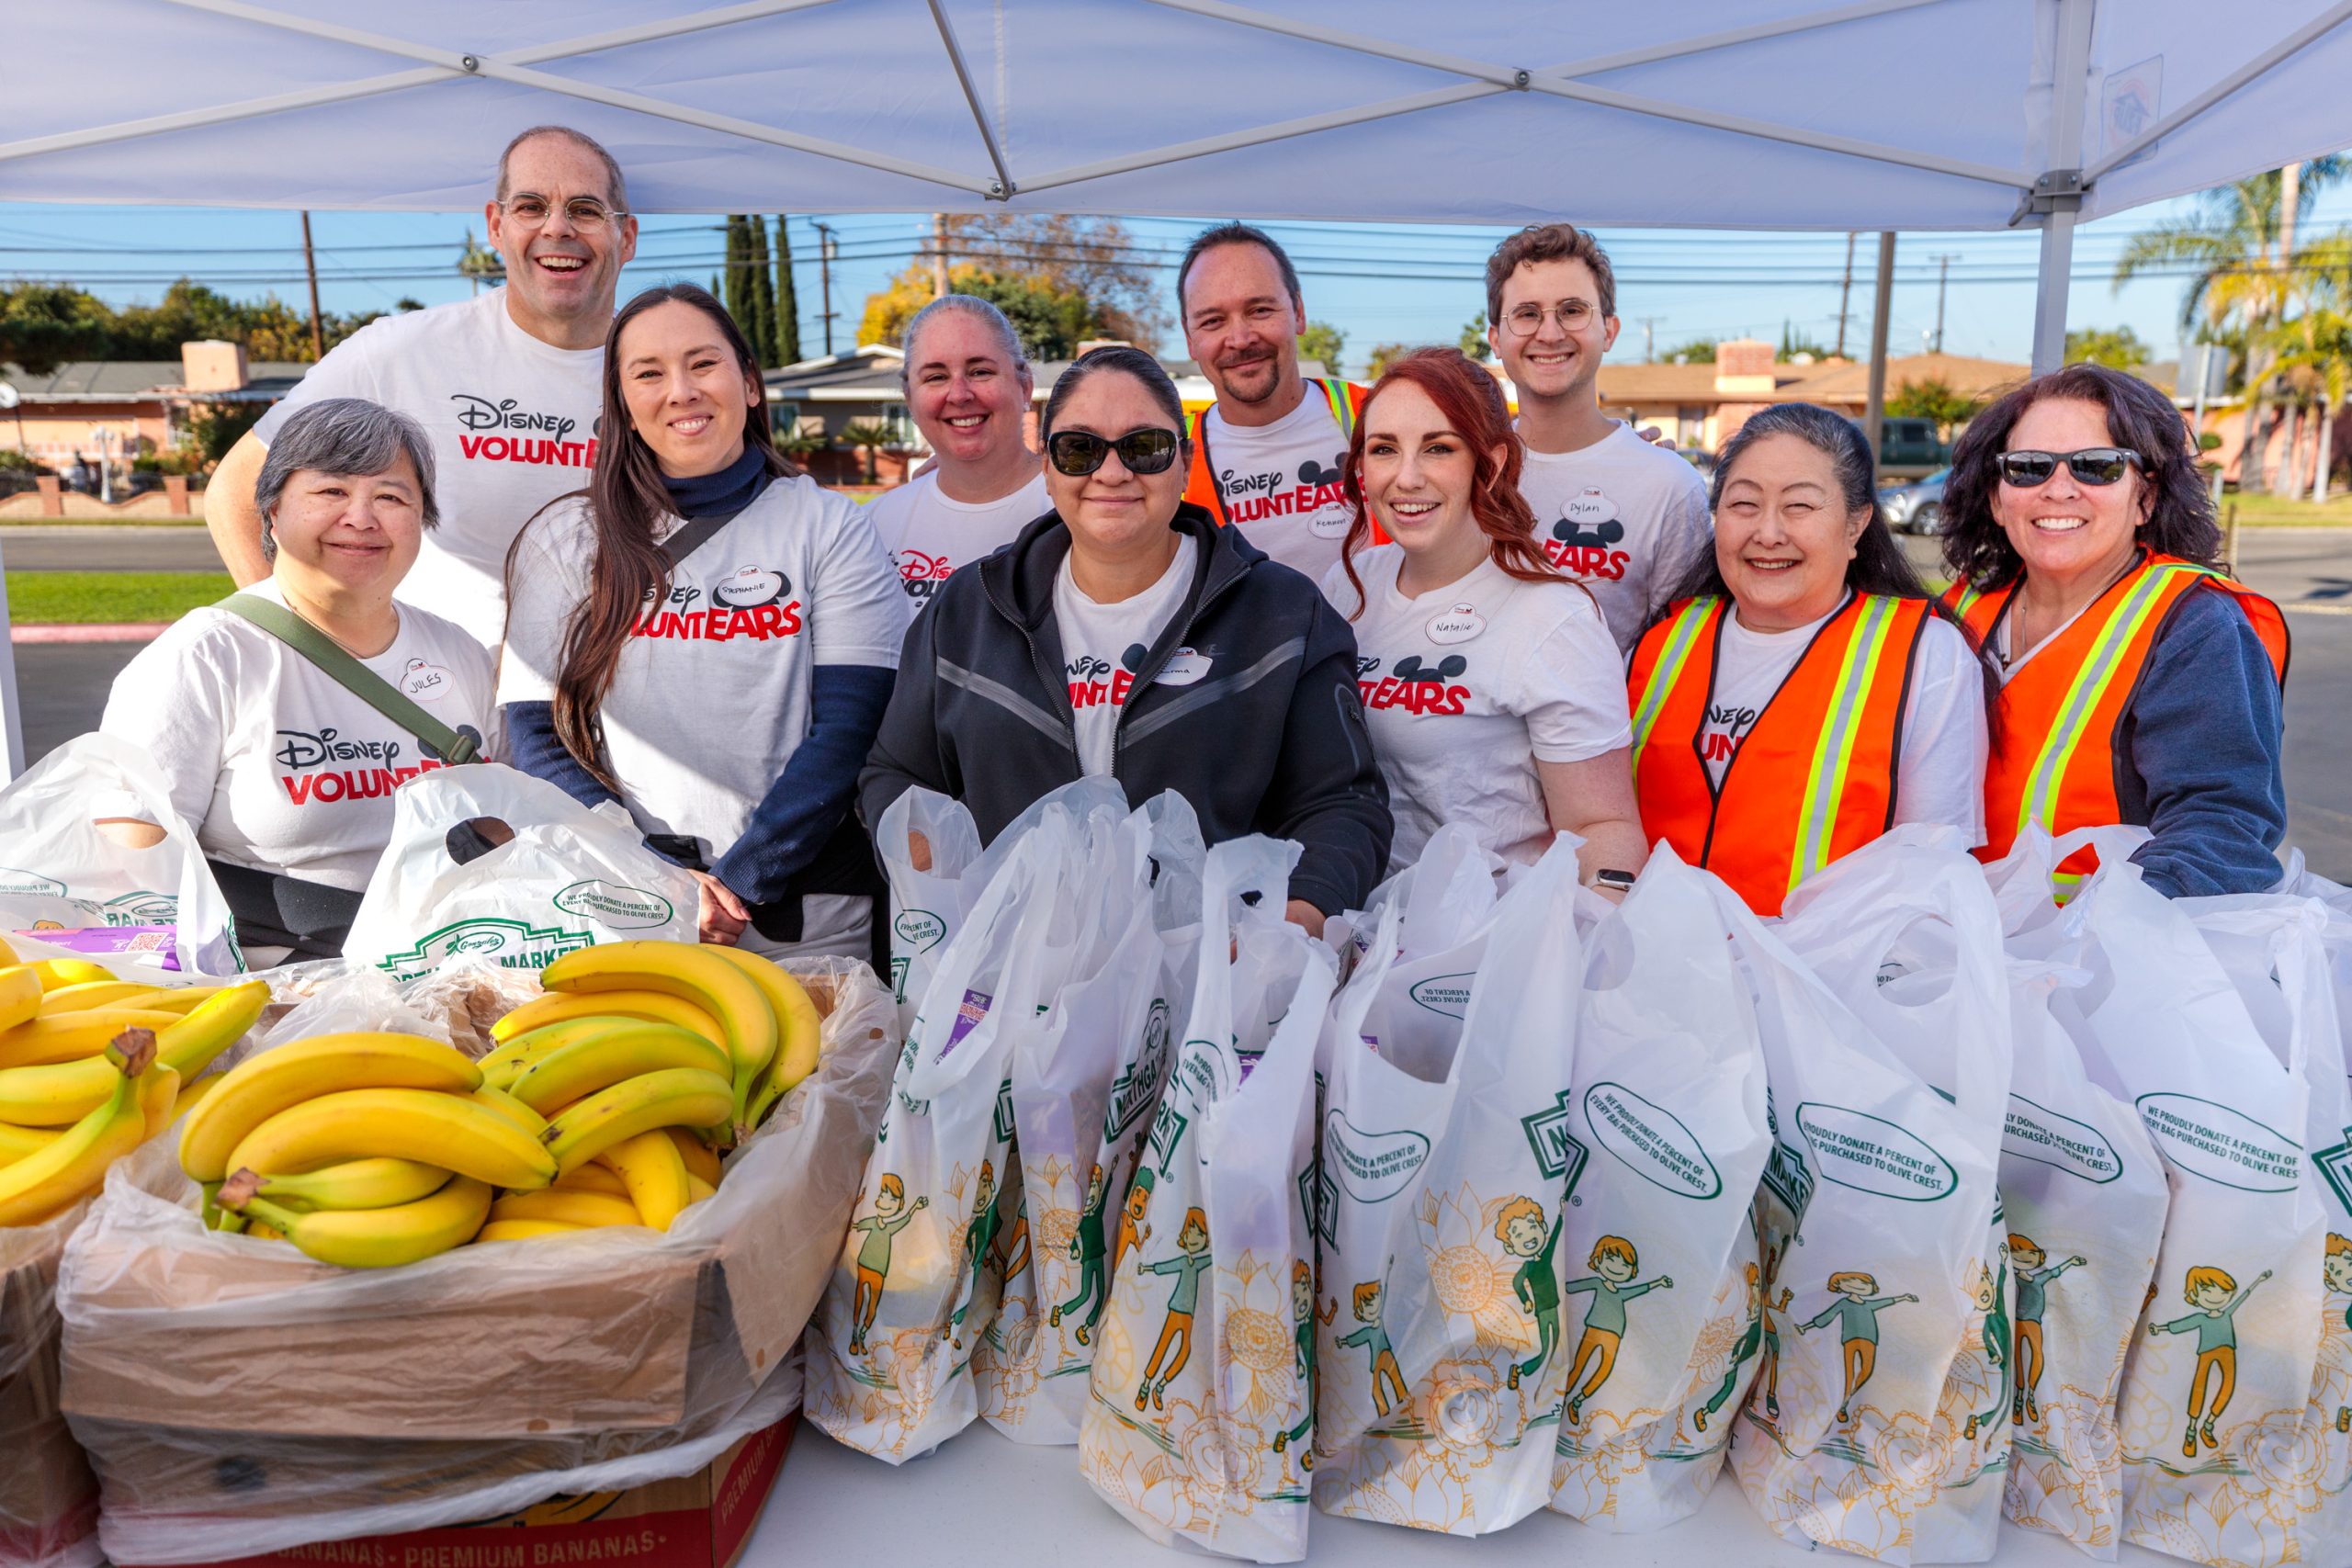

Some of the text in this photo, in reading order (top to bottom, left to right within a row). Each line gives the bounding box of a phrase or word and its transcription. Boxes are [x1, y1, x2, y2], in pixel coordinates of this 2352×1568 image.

[1570, 503, 1600, 514] Dylan
[1436, 622, 1475, 632] Natalie
[410, 672, 442, 694] JULES
[603, 897, 622, 908] DONATE
[627, 903, 653, 911] PERCENT
[920, 929, 940, 939] CREST.
[1589, 1094, 1611, 1115] EVERY
[1618, 1123, 1650, 1152] PURCHASED
[1648, 1146, 1659, 1160] TO
[1659, 1155, 1681, 1176] OLIVE
[1604, 1093, 1704, 1177] WE PROUDLY DONATE A PERCENT OF
[2056, 1134, 2096, 1156] PERCENT
[2148, 1104, 2299, 1167] WE PROUDLY DONATE A PERCENT OF
[2161, 1123, 2176, 1138] BAG
[2177, 1131, 2227, 1157] PURCHASED
[2229, 1150, 2241, 1163] TO
[2242, 1156, 2269, 1173] OLIVE
[1370, 1158, 1376, 1168] A
[1376, 1147, 1407, 1167] PERCENT
[1407, 1144, 1416, 1156] OF
[1818, 1142, 1872, 1167] PURCHASED
[1874, 1157, 1886, 1170] TO
[1886, 1163, 1912, 1181] OLIVE
[1913, 1172, 1944, 1191] CREST.
[1839, 1134, 1875, 1154] DONATE
[1876, 1146, 1883, 1156] A
[1884, 1148, 1922, 1171] PERCENT
[1924, 1164, 1937, 1176] OF
[1370, 1169, 1381, 1180] TO
[1381, 1162, 1401, 1178] OLIVE
[721, 1438, 765, 1526] PREMIUM
[404, 1544, 525, 1568] PREMIUM
[533, 1529, 655, 1565] BANANAS
